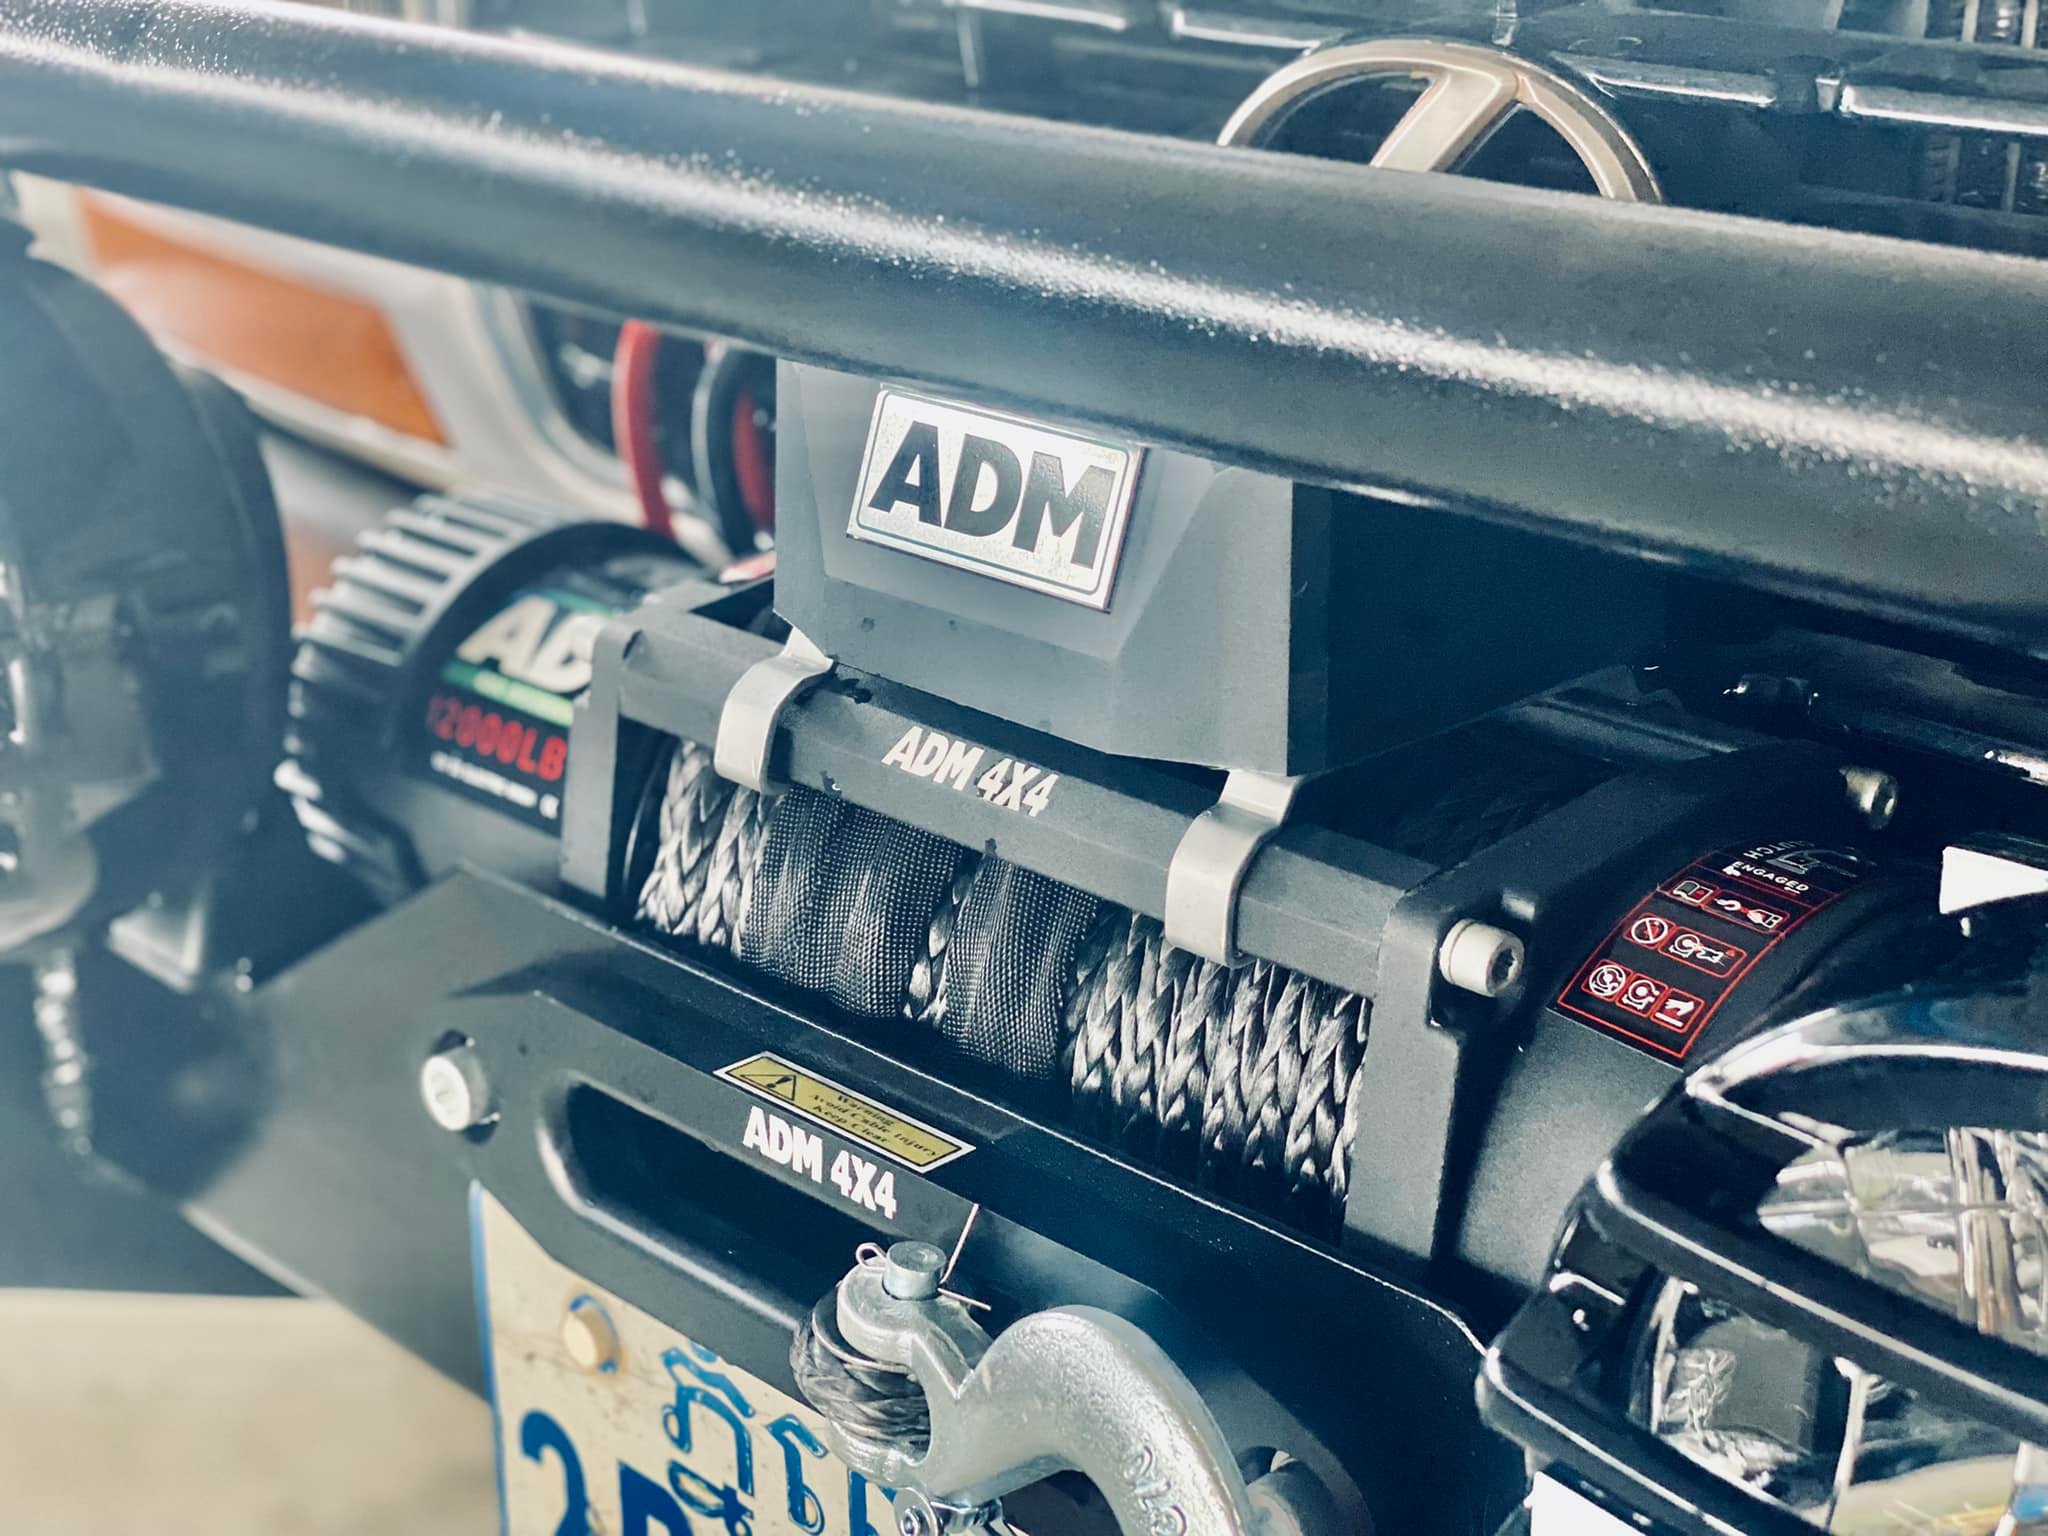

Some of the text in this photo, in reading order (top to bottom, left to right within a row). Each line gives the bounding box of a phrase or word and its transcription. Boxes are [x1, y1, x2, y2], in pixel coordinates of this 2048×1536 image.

[868, 420, 1116, 570] ADM
[881, 725, 1060, 817] ADM 4X4
[1732, 861, 1809, 892] ENGAGED
[837, 1094, 895, 1127] Warning
[742, 1105, 897, 1219] ADM 4X4
